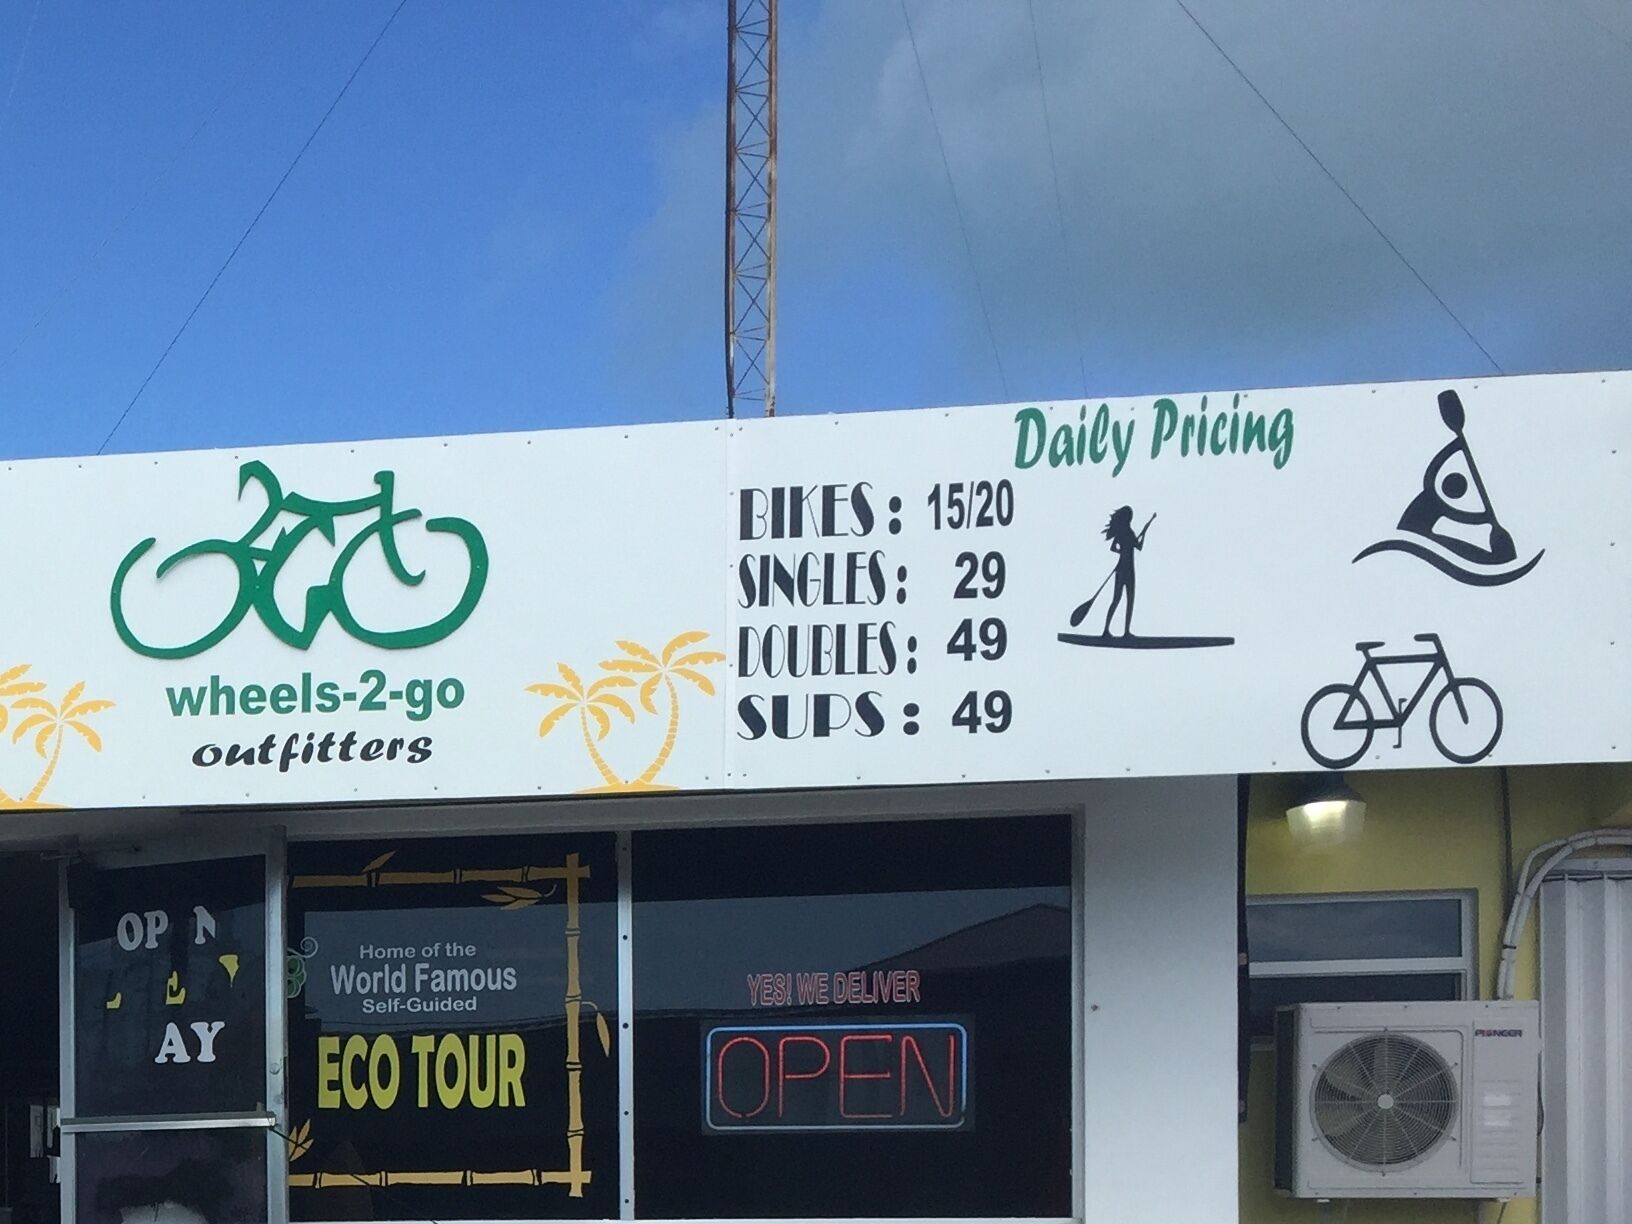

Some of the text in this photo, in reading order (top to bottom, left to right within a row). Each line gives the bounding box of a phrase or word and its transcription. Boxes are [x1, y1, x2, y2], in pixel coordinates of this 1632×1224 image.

[1015, 393, 1294, 477] Daily Pricing
[927, 479, 1014, 530] 15/20
[953, 551, 1006, 599] 29
[947, 617, 1008, 661] 49
[165, 669, 465, 721] wheels-2-go
[952, 690, 1012, 734] 49
[192, 731, 433, 772] outfitters
[360, 942, 476, 959] Home of the
[330, 963, 517, 995] World Famous
[747, 970, 921, 1006] YES! WE DELIVER
[362, 996, 477, 1014] Self-Guided
[318, 1033, 526, 1109] ECO TOUR
[718, 1034, 955, 1118] OPEN
